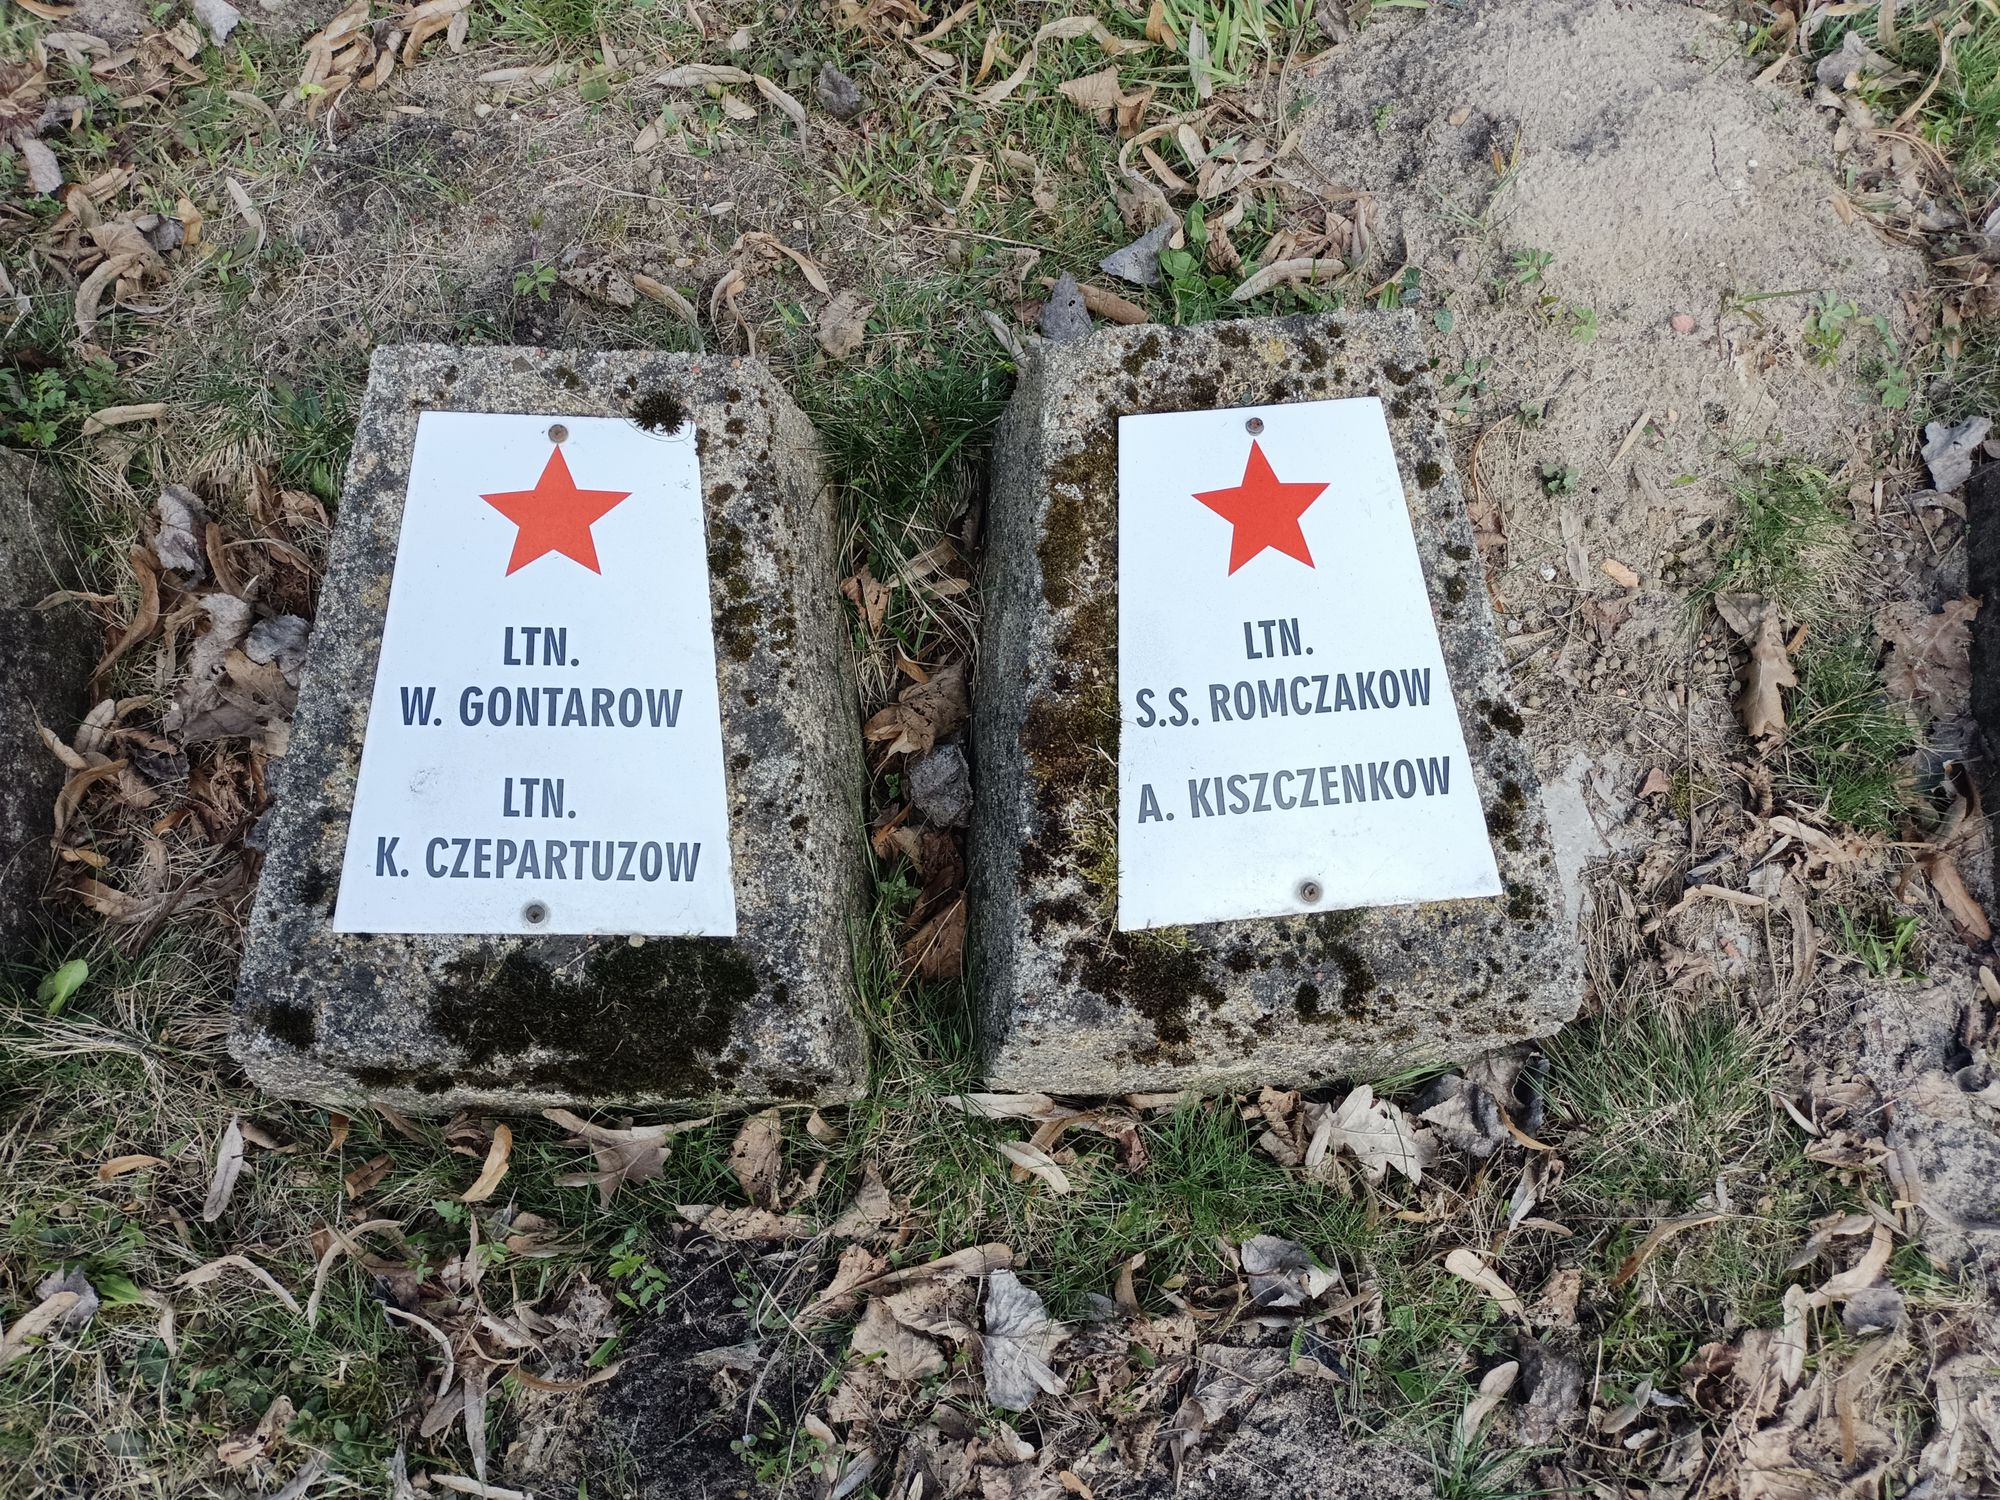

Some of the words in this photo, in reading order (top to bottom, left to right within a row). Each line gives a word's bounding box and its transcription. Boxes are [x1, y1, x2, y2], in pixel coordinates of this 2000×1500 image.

[503, 626, 580, 667] LTN.
[1243, 617, 1314, 660] LTN.
[400, 686, 442, 727] W.
[459, 685, 683, 728] GONTAROW
[1136, 687, 1200, 728] S.S.
[1208, 667, 1431, 722] ROMCZAKOW
[502, 777, 577, 819] LTN.
[1138, 783, 1175, 824] A.
[1188, 755, 1450, 819] KISZCZENKOW
[375, 836, 409, 878] K.
[425, 837, 701, 882] CZEPARTUZOW
